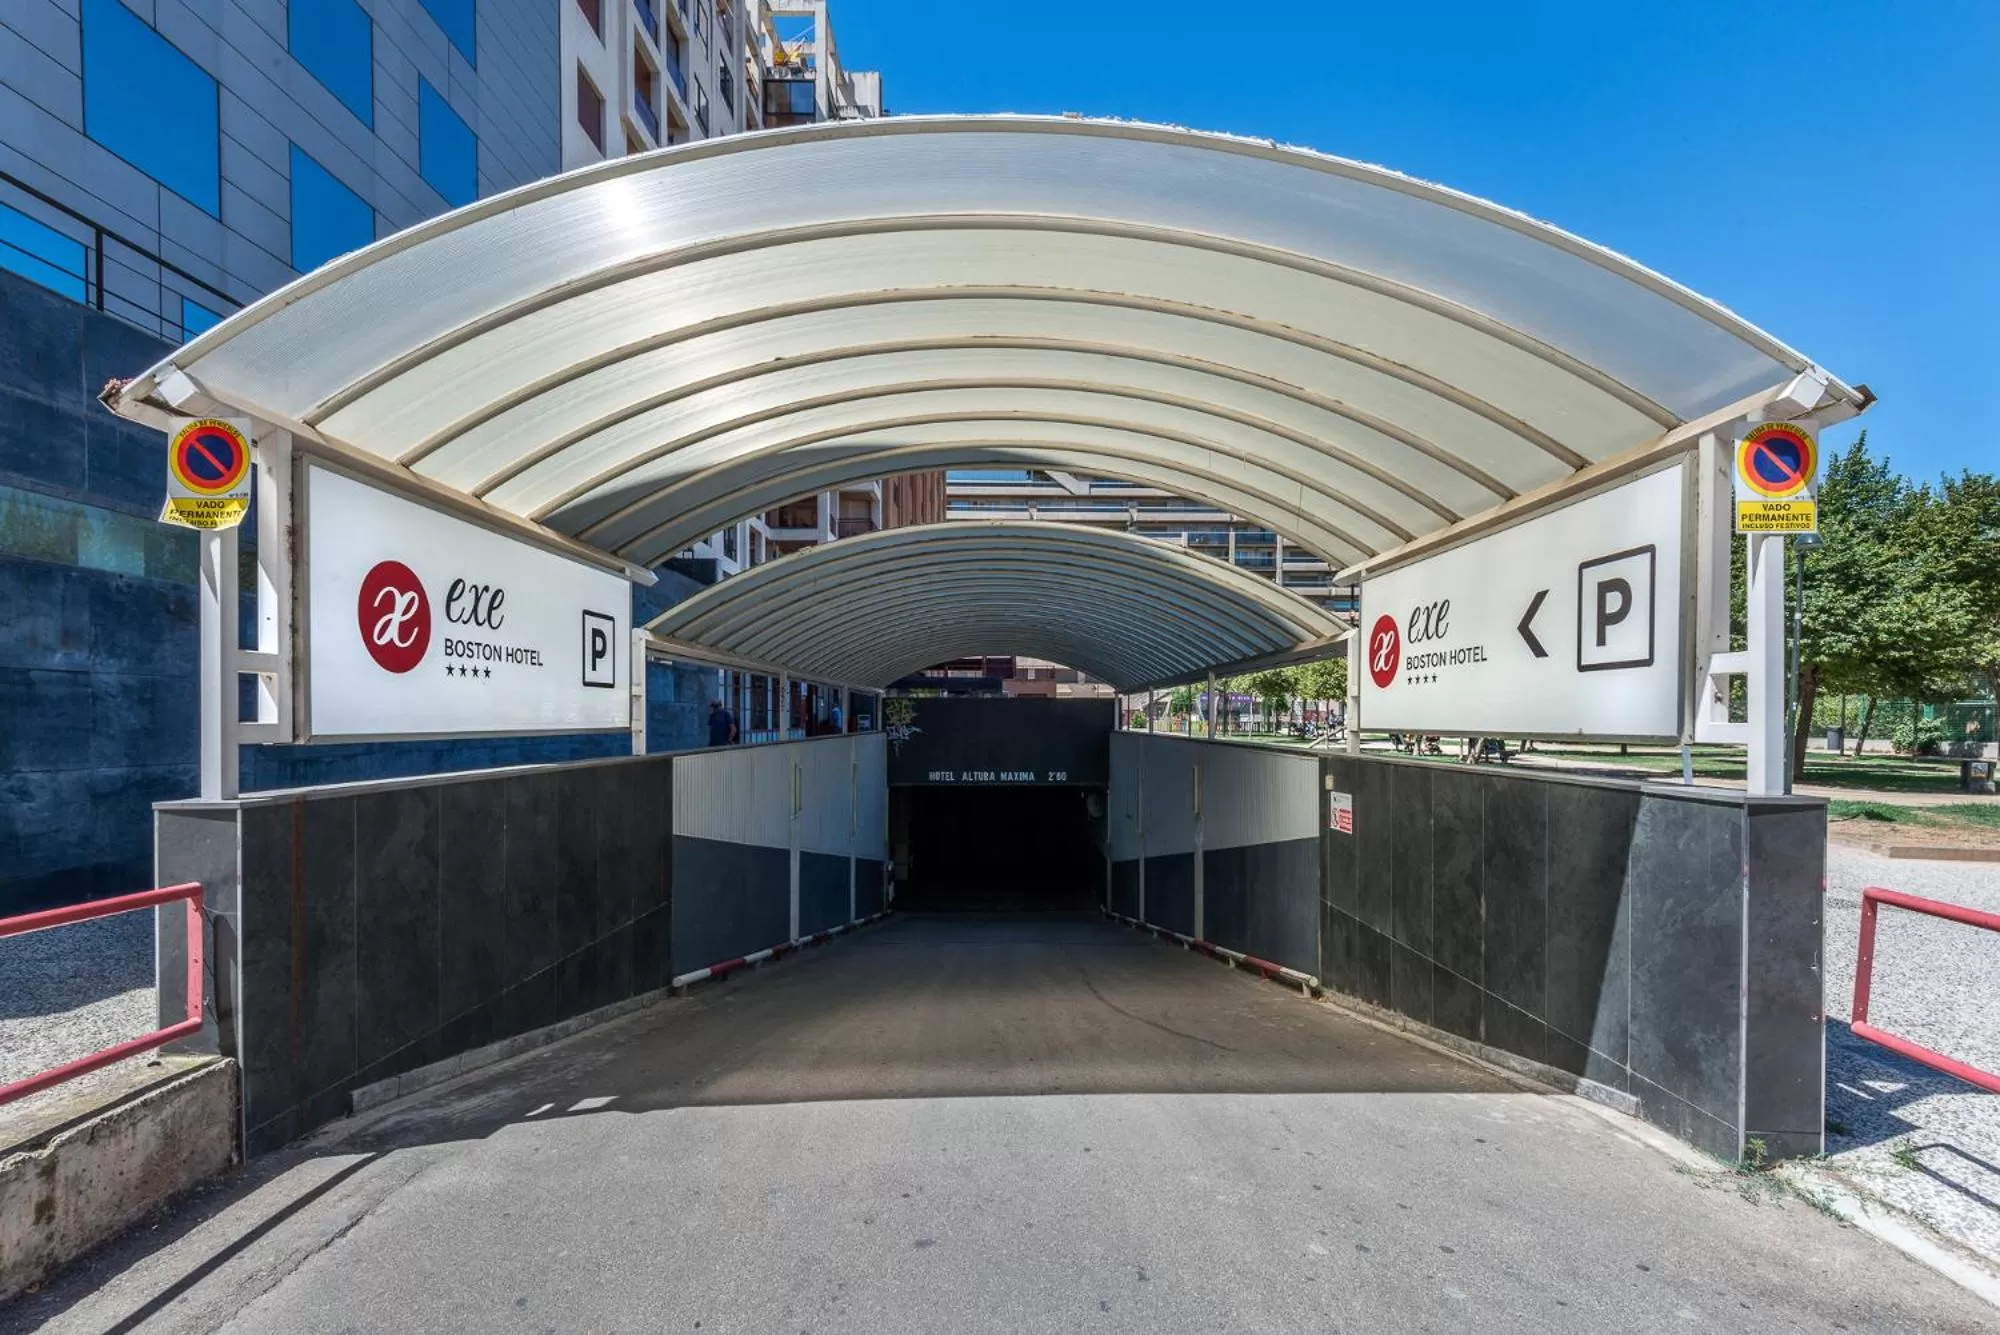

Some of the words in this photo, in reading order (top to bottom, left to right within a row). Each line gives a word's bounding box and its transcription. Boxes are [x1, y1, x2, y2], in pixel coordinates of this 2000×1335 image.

[1741, 513, 1812, 522] PERMANENTE
[1762, 503, 1791, 511] VADO
[445, 578, 505, 630] exe
[1596, 577, 1633, 647] P
[1407, 599, 1450, 644] exe
[444, 638, 502, 662] BOSTON
[506, 647, 543, 666] HOTEL
[591, 627, 607, 671] P
[1406, 651, 1447, 670] BOSTON
[1450, 645, 1487, 665] HOTEL
[928, 771, 955, 781] HOTEL
[961, 771, 996, 781] ALTURA
